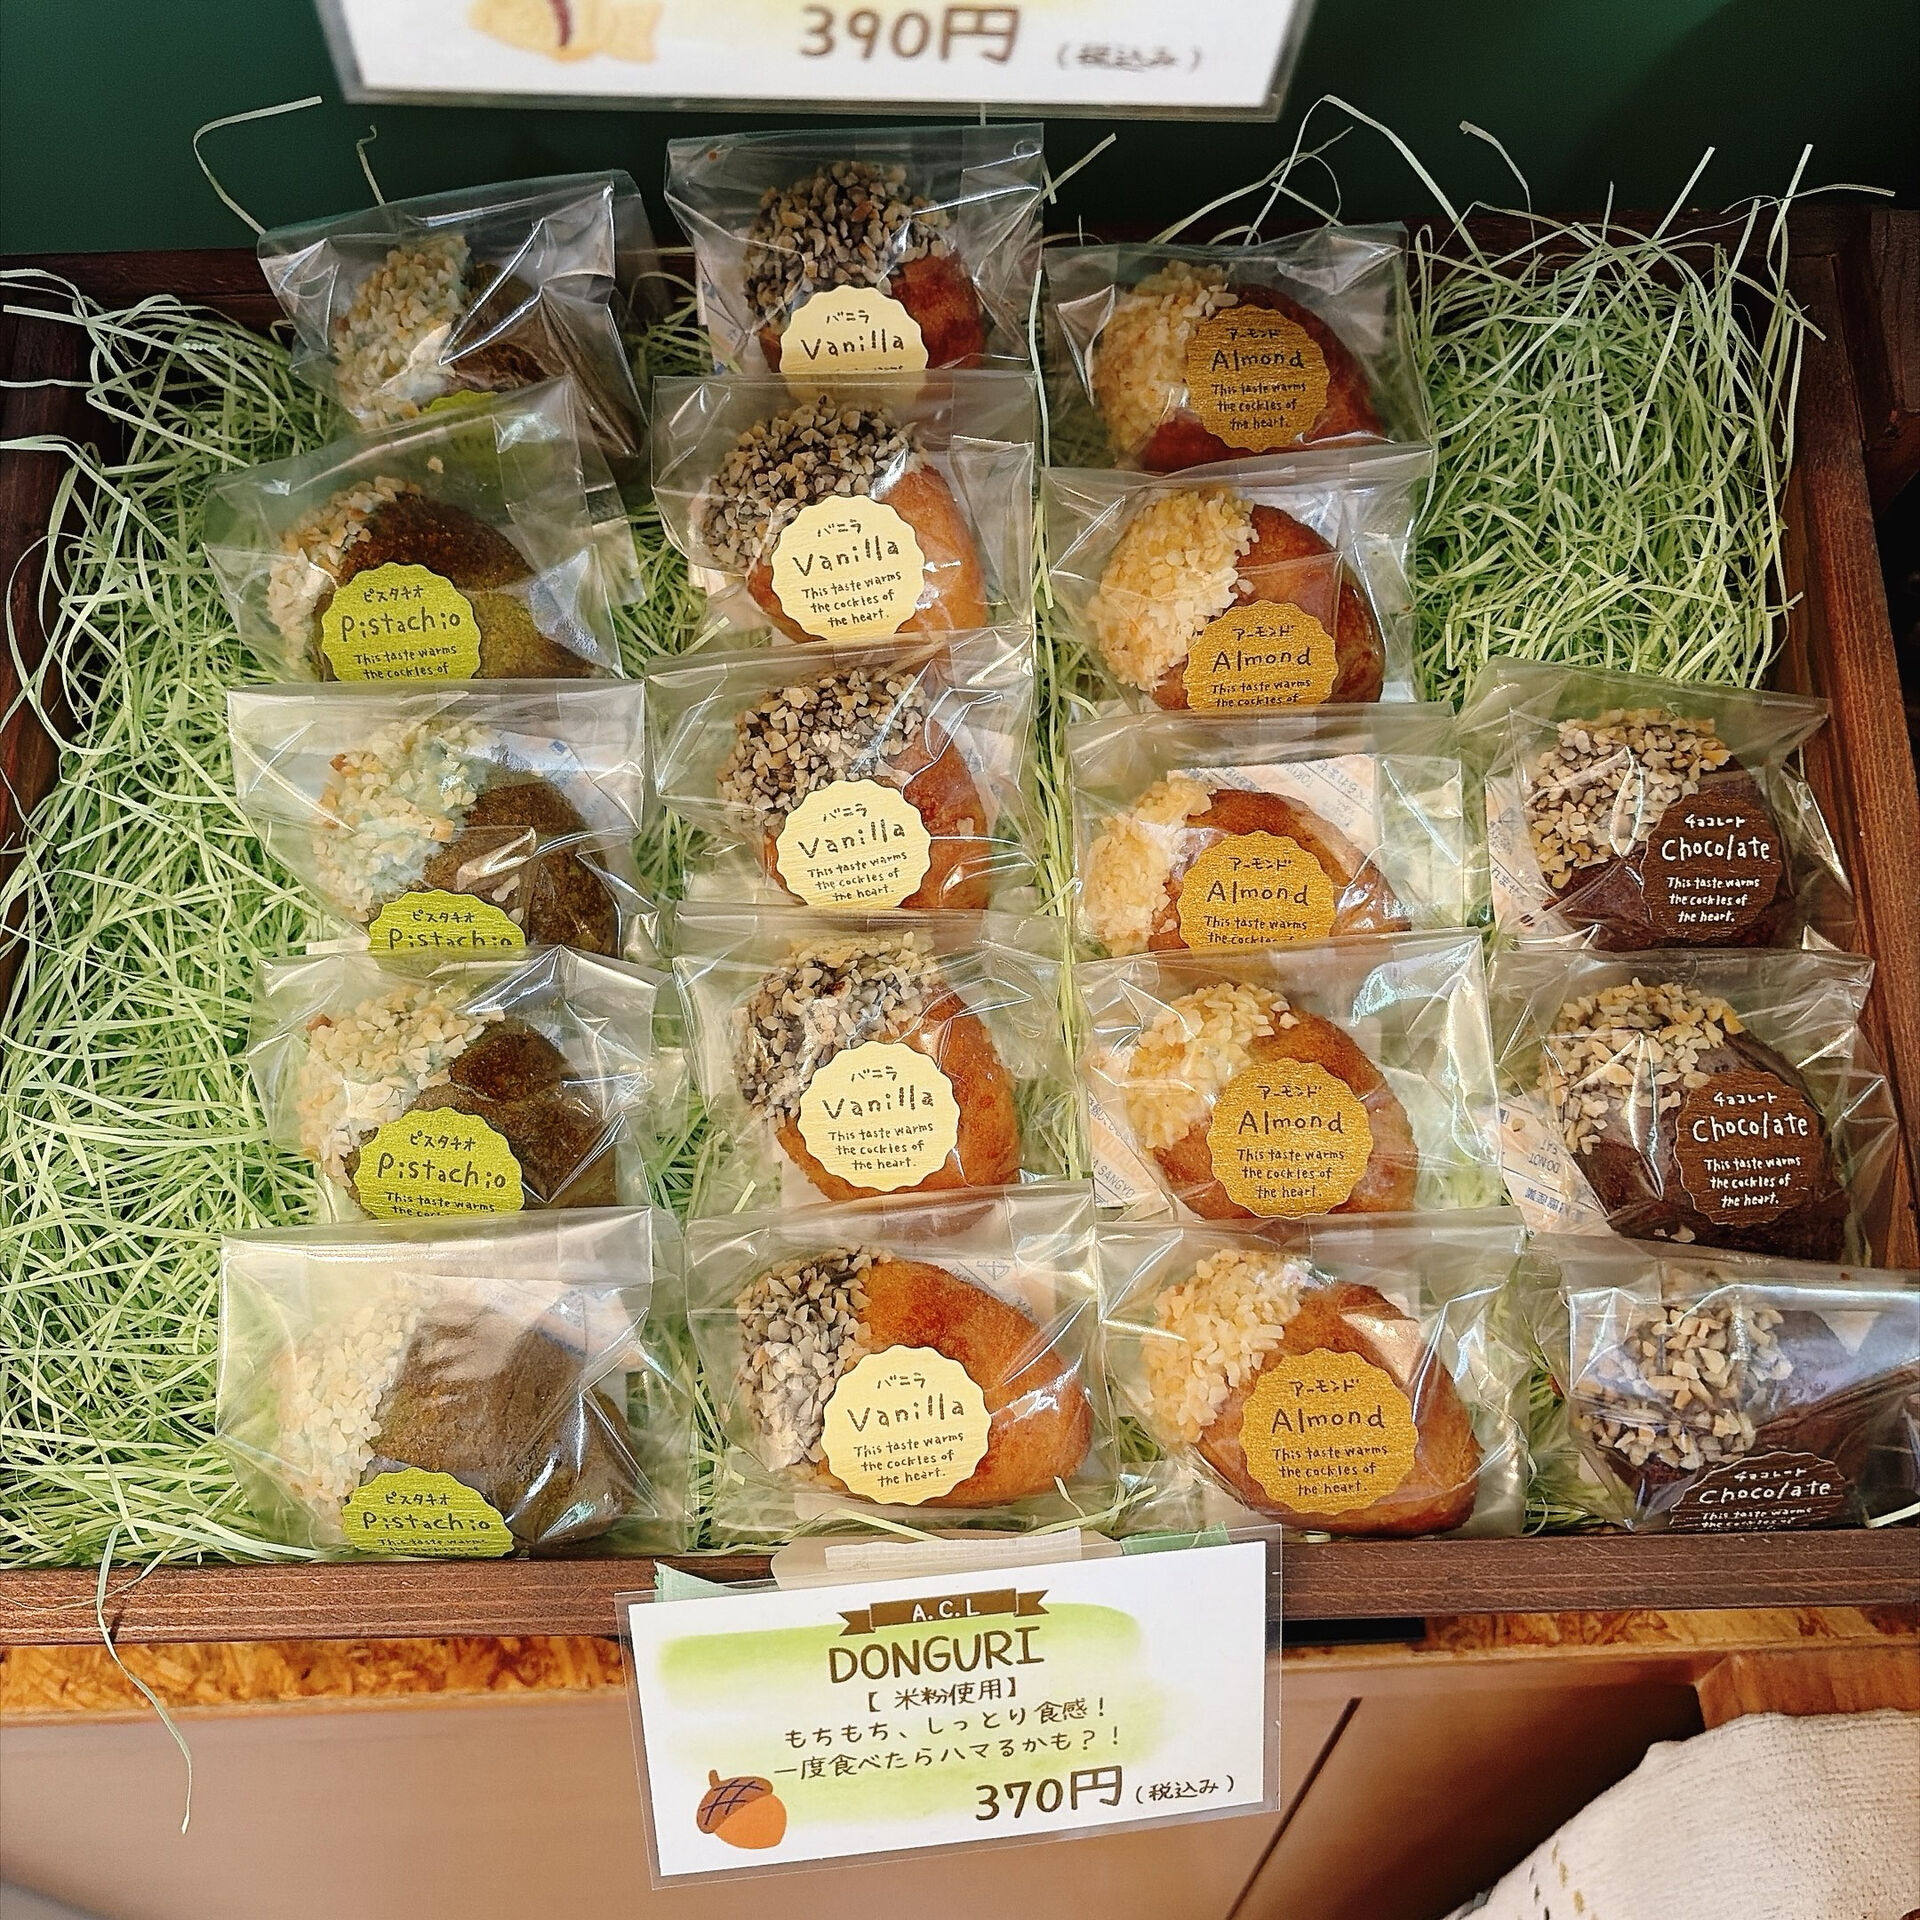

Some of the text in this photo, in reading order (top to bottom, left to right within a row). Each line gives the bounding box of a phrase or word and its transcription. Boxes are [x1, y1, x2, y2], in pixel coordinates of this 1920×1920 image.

[800, 6, 1019, 65] 390円
[826, 310, 870, 324] バニラ
[1226, 328, 1280, 340] アーモンド
[801, 329, 904, 360] Vanilla
[1211, 349, 1305, 372] Almond
[1212, 383, 1306, 396] This taste warms
[1217, 399, 1297, 412] the cockles of
[1230, 418, 1248, 430] the
[818, 519, 861, 537] バニラ
[792, 536, 899, 576] Vanilla
[363, 585, 424, 602] ピスタチオ
[801, 572, 902, 599] This taste warms
[811, 589, 894, 613] the cockles of
[342, 607, 460, 642] Pistachio
[828, 608, 889, 628] the heart.
[1232, 625, 1294, 641] アーモンド
[354, 646, 457, 665] This taste warms
[1213, 647, 1311, 673] Almond
[363, 662, 449, 680] the cockles of
[1212, 680, 1311, 695] This taste warms
[1215, 694, 1299, 708] the cockles of
[823, 803, 867, 822] バニラ
[1685, 814, 1745, 828] チョコレート
[798, 819, 905, 858] Vanilla
[1662, 834, 1770, 861] Chocolate
[807, 852, 907, 879] This taste warms
[1229, 857, 1292, 871] アーモンド
[815, 868, 899, 890] the cockles of
[1667, 877, 1760, 889] This taste warms
[833, 884, 894, 901] the heart.
[1207, 880, 1308, 906] Almond
[1669, 894, 1748, 906] the cockles of
[413, 910, 474, 923] ピスタチオ
[1204, 916, 1307, 930] This taste warms
[1678, 910, 1735, 922] the heart.
[1208, 932, 1227, 943] the
[851, 1066, 897, 1082] バニラ
[1258, 1085, 1322, 1099] アーモンド
[1714, 1091, 1778, 1107] チョコレート
[822, 1085, 934, 1119] Vanilla
[1238, 1110, 1344, 1134] Almond
[1693, 1111, 1808, 1142] Chocolate
[410, 1130, 476, 1151] ピスタチオ
[828, 1123, 933, 1142] This taste warms
[836, 1140, 924, 1155] the cockles of
[1237, 1149, 1345, 1162] This taste warms
[377, 1152, 506, 1188] Pistachio
[852, 1157, 916, 1171] the heart.
[1704, 1157, 1800, 1172] This taste warms
[1242, 1167, 1332, 1179] the cockles of
[1710, 1173, 1791, 1189] the cockles of
[1256, 1185, 1322, 1199] the heart.
[1721, 1192, 1779, 1208] the heart.
[384, 1191, 495, 1212] This taste warms
[392, 1205, 412, 1216] the
[877, 1372, 925, 1389] バニラ
[1290, 1379, 1359, 1396] アーモンド
[847, 1393, 964, 1432] Vanilla
[1272, 1405, 1385, 1433] Almond
[853, 1433, 964, 1457] This taste warms
[1272, 1446, 1388, 1461] This taste warms
[861, 1449, 954, 1472] the cockles of
[877, 1467, 945, 1487] the heart.
[1279, 1462, 1376, 1478] the cockles of
[1734, 1468, 1807, 1482] チョコレート
[1296, 1480, 1367, 1496] the heart.
[1699, 1480, 1831, 1504] Chocolate
[386, 1491, 449, 1505] ピスタチオ
[362, 1511, 490, 1531] Pistachio
[912, 1599, 980, 1622] A.C.L
[828, 1626, 1045, 1683] DONGURI
[976, 1765, 1234, 1821] 370円 (税込み)
